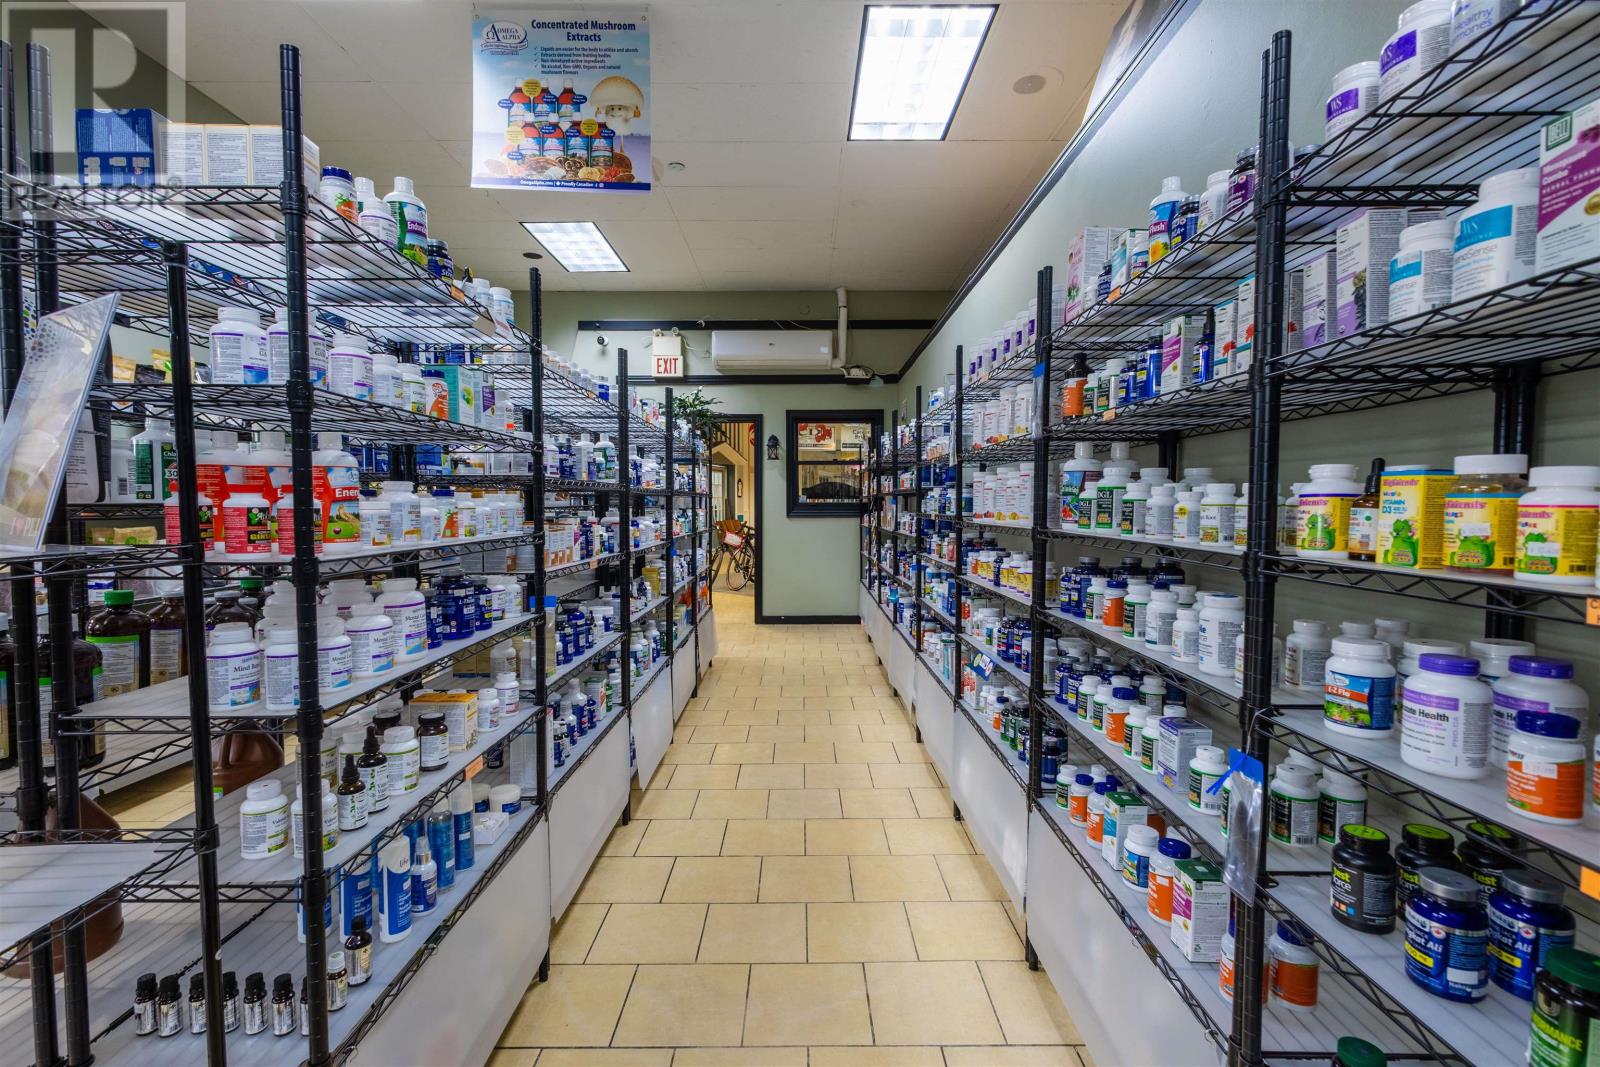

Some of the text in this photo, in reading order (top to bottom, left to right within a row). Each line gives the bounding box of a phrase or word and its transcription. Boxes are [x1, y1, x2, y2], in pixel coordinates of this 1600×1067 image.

[531, 19, 636, 31] Concentrated Mushroom
[566, 32, 602, 42] Extracts
[656, 357, 679, 374] EXIT
[1418, 708, 1449, 723] Health
